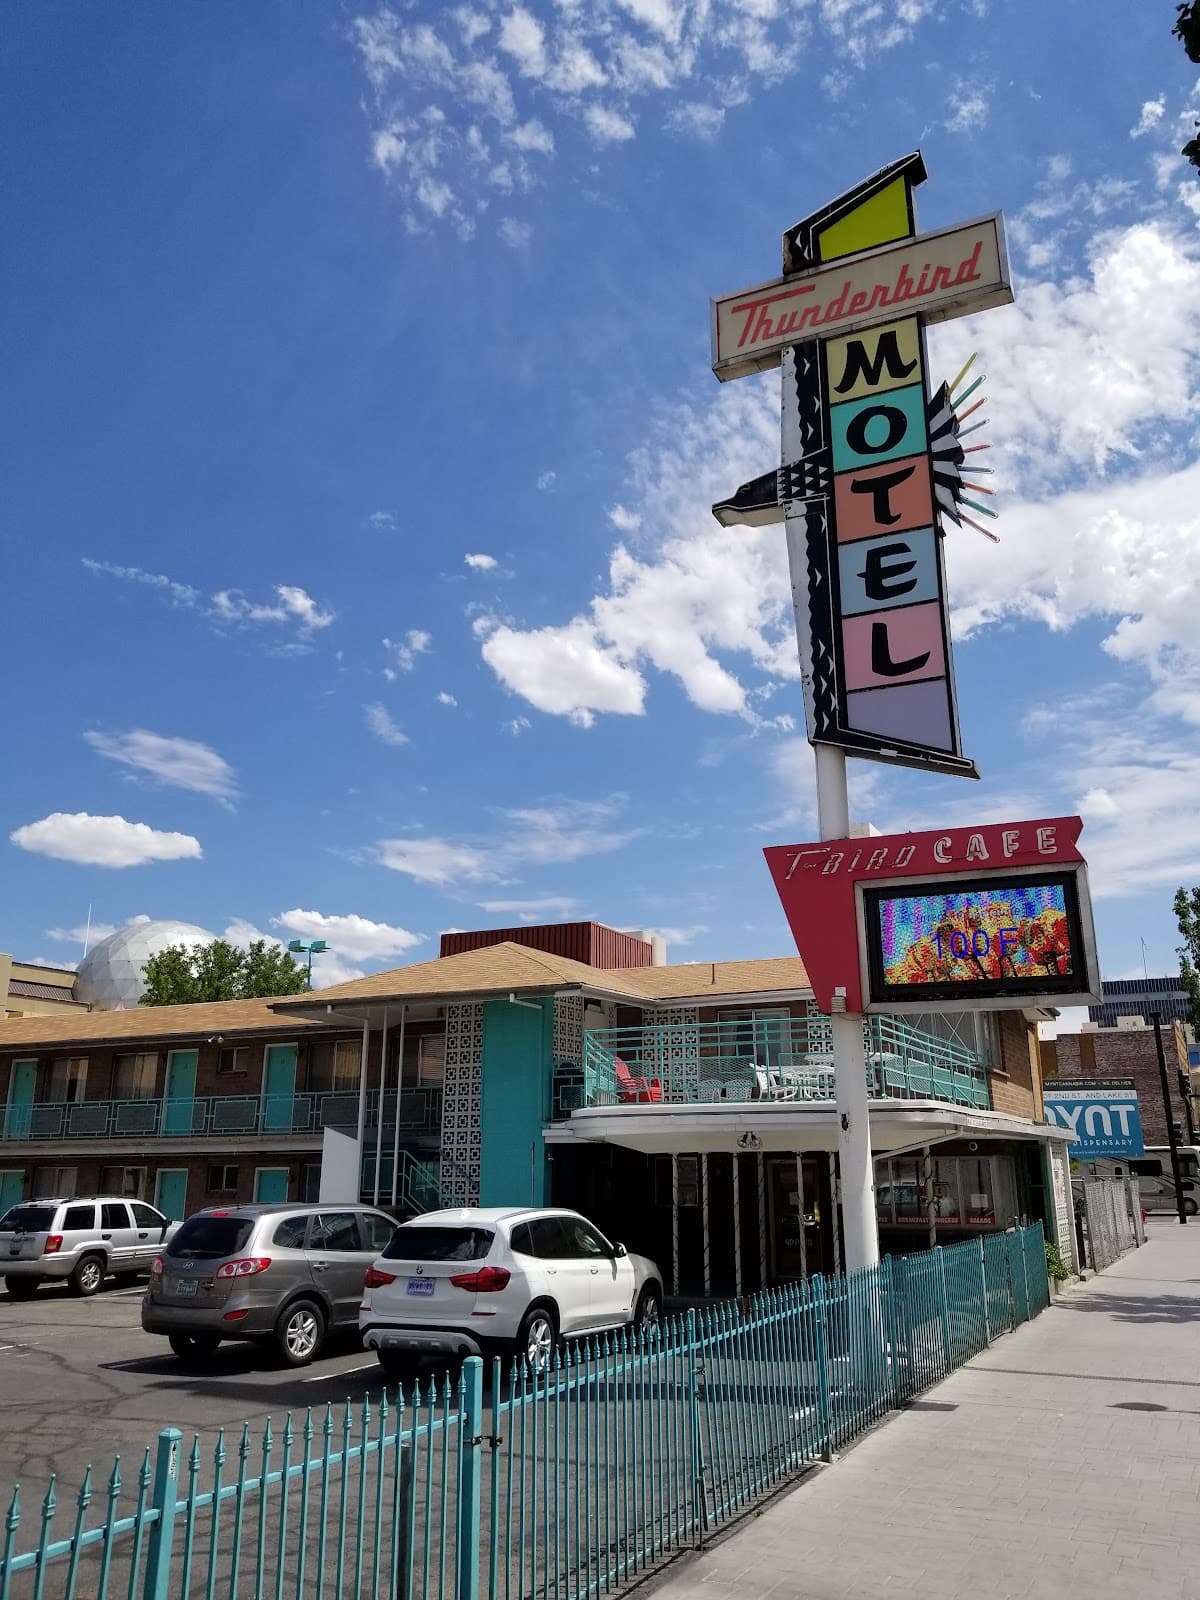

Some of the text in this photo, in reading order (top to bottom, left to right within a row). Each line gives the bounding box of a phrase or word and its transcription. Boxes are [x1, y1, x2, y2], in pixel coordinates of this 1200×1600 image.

[731, 241, 983, 347] Thunderbird
[833, 329, 931, 678] MOTEL
[785, 826, 1058, 880] T-BIRD CAFE
[931, 927, 1019, 960] 100 F
